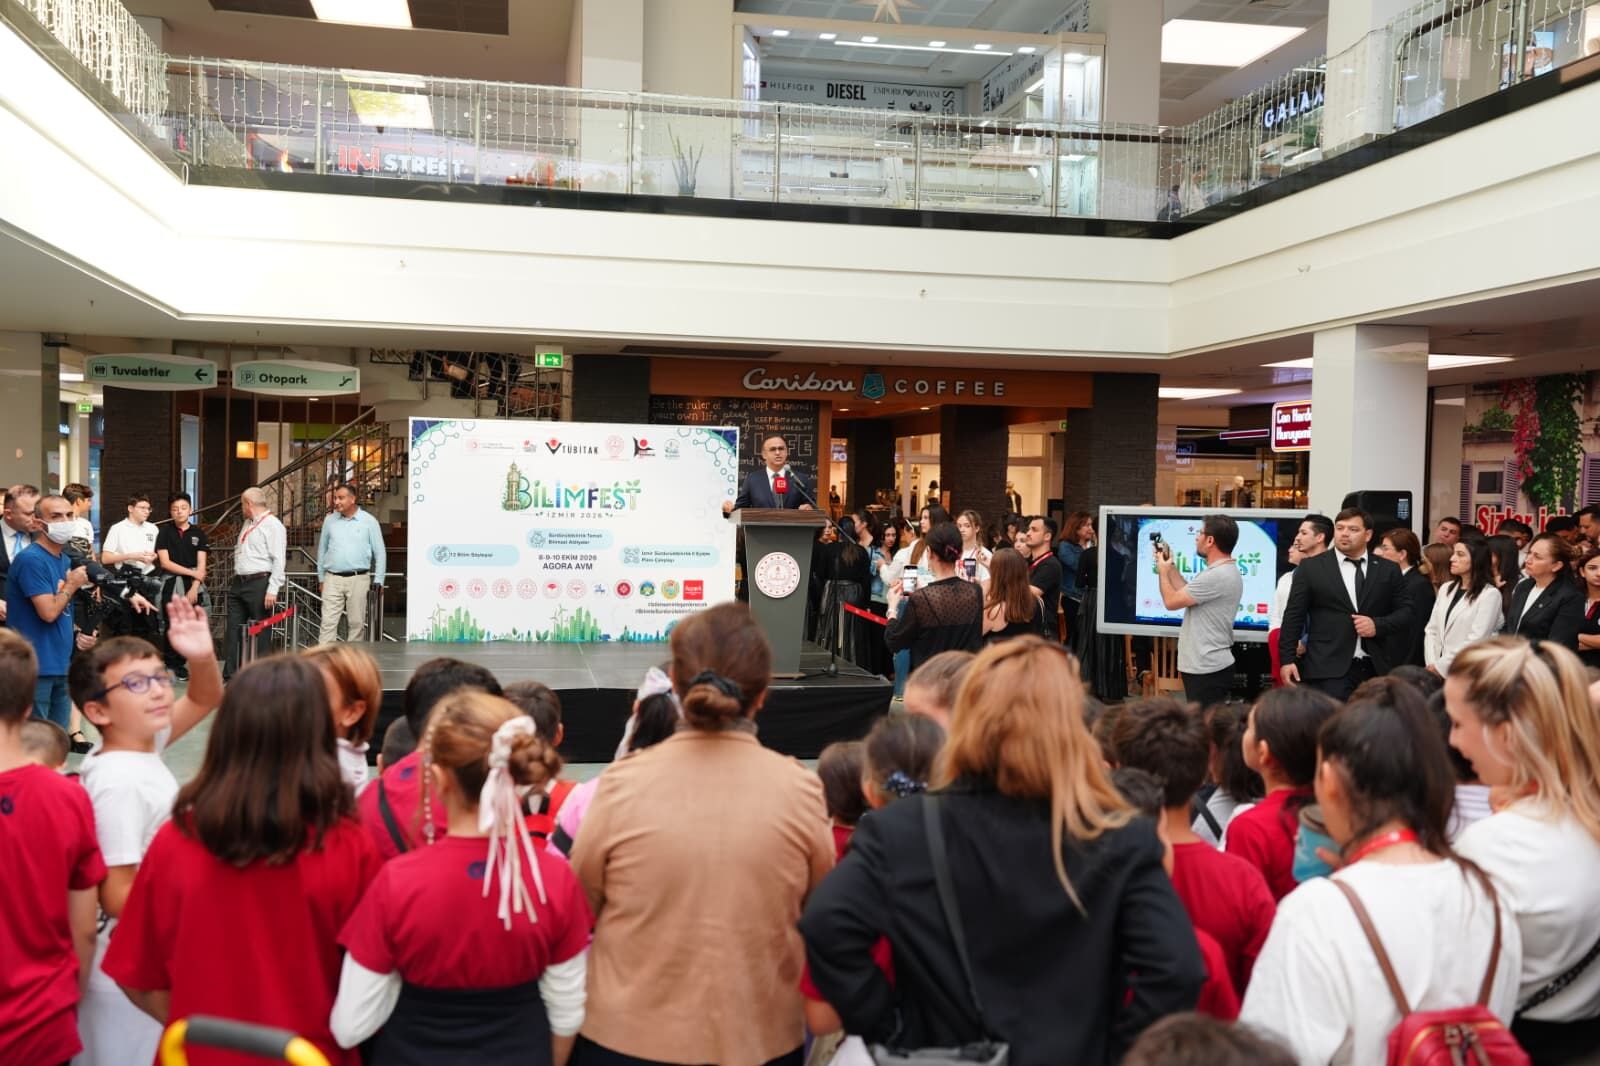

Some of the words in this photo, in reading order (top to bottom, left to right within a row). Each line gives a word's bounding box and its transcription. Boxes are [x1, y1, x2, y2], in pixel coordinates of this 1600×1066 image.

[770, 81, 815, 92] HILFIGER
[826, 82, 867, 101] DIESEL
[384, 153, 465, 177] STREET
[111, 365, 171, 378] Tuvaletler
[258, 373, 308, 386] Otopark
[743, 367, 856, 391] Caribou
[895, 379, 1006, 396] COFFEE
[686, 399, 710, 409] ruler
[741, 399, 769, 412] Adopt
[677, 411, 698, 421] own
[702, 410, 718, 421] life
[1276, 410, 1291, 424] Can
[753, 432, 813, 457] LFE
[543, 562, 573, 570] AGORA
[574, 562, 593, 570] AVM
